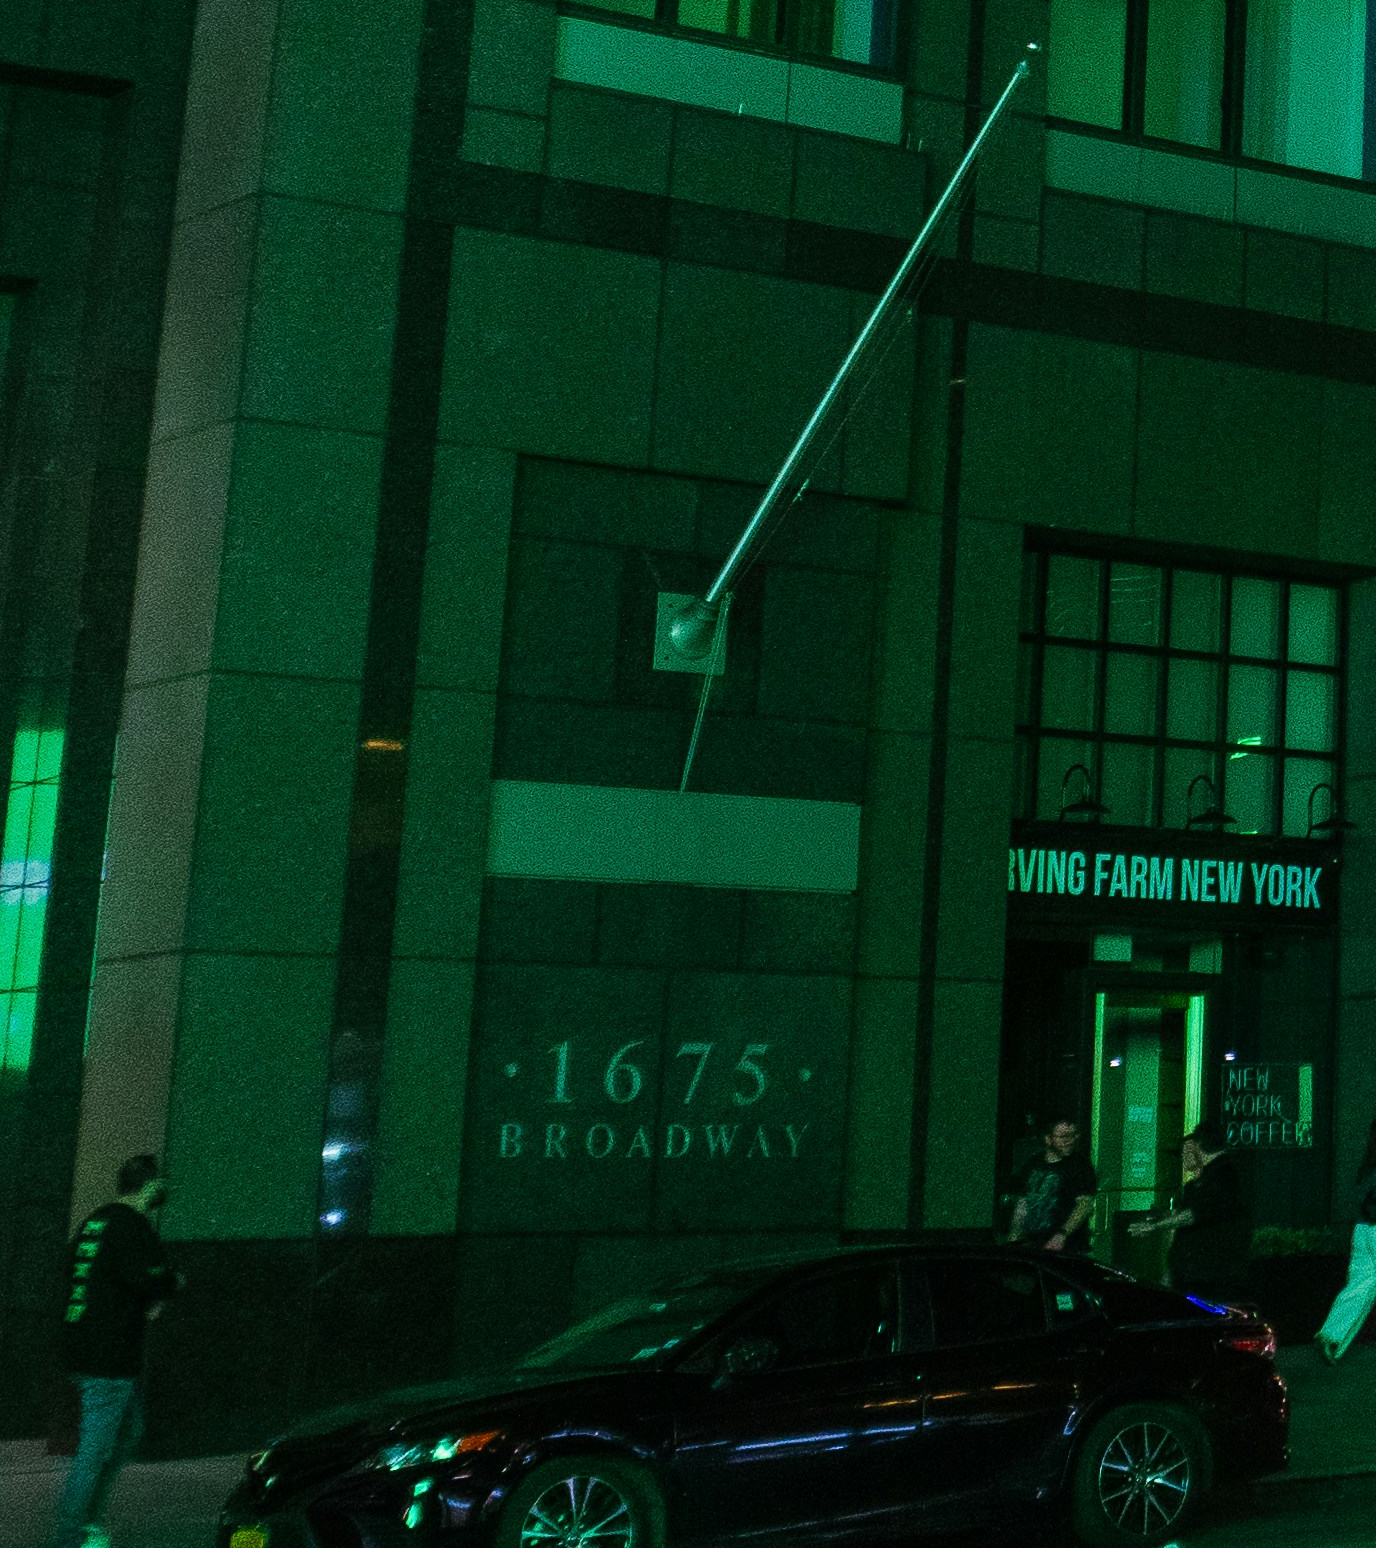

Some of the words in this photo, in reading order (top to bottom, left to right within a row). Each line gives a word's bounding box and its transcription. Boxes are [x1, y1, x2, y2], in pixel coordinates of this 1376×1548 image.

[1094, 853, 1173, 900] FARM
[1180, 858, 1243, 904] NEW
[1250, 862, 1323, 909] YORK
[545, 1039, 768, 1106] 1675
[1227, 1067, 1270, 1091] NEW
[1225, 1094, 1282, 1116] YORK
[499, 1122, 809, 1158] BROADWAY
[1226, 1121, 1313, 1147] COFFEE
